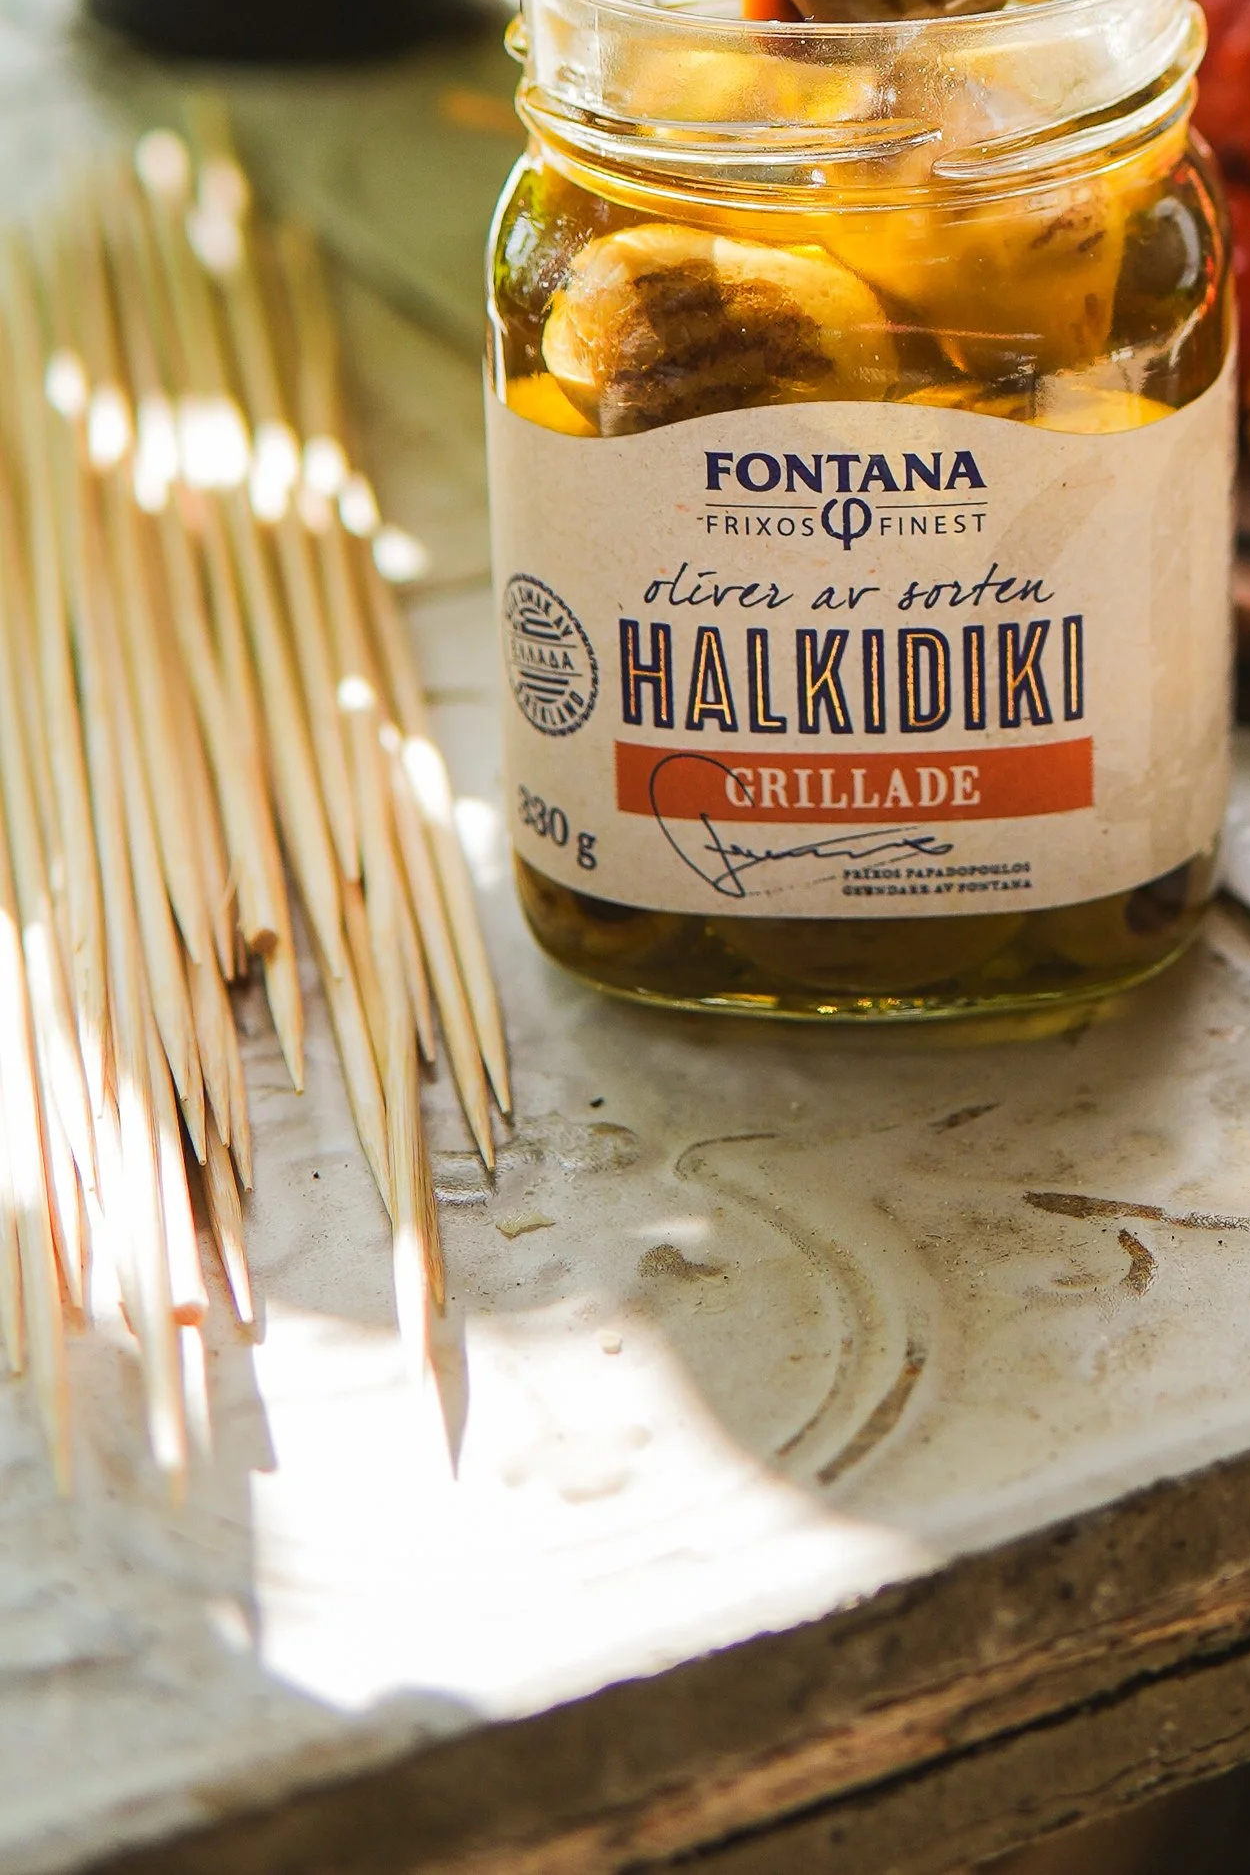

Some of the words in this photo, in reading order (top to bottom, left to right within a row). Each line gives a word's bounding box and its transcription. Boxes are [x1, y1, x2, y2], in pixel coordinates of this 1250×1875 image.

[703, 450, 988, 494] FONTANA
[706, 514, 815, 537] FRIXOS
[880, 513, 987, 537] FINEST
[643, 561, 794, 610] oliver
[811, 586, 881, 611] av
[897, 561, 1055, 611] sorten
[618, 614, 1084, 735] HALKIDIKI
[723, 765, 982, 809] GRILLADE
[576, 831, 598, 870] g
[906, 861, 1032, 879] PAPADOPOULOS
[934, 882, 955, 895] AV
[957, 879, 1033, 895] FONTANA
